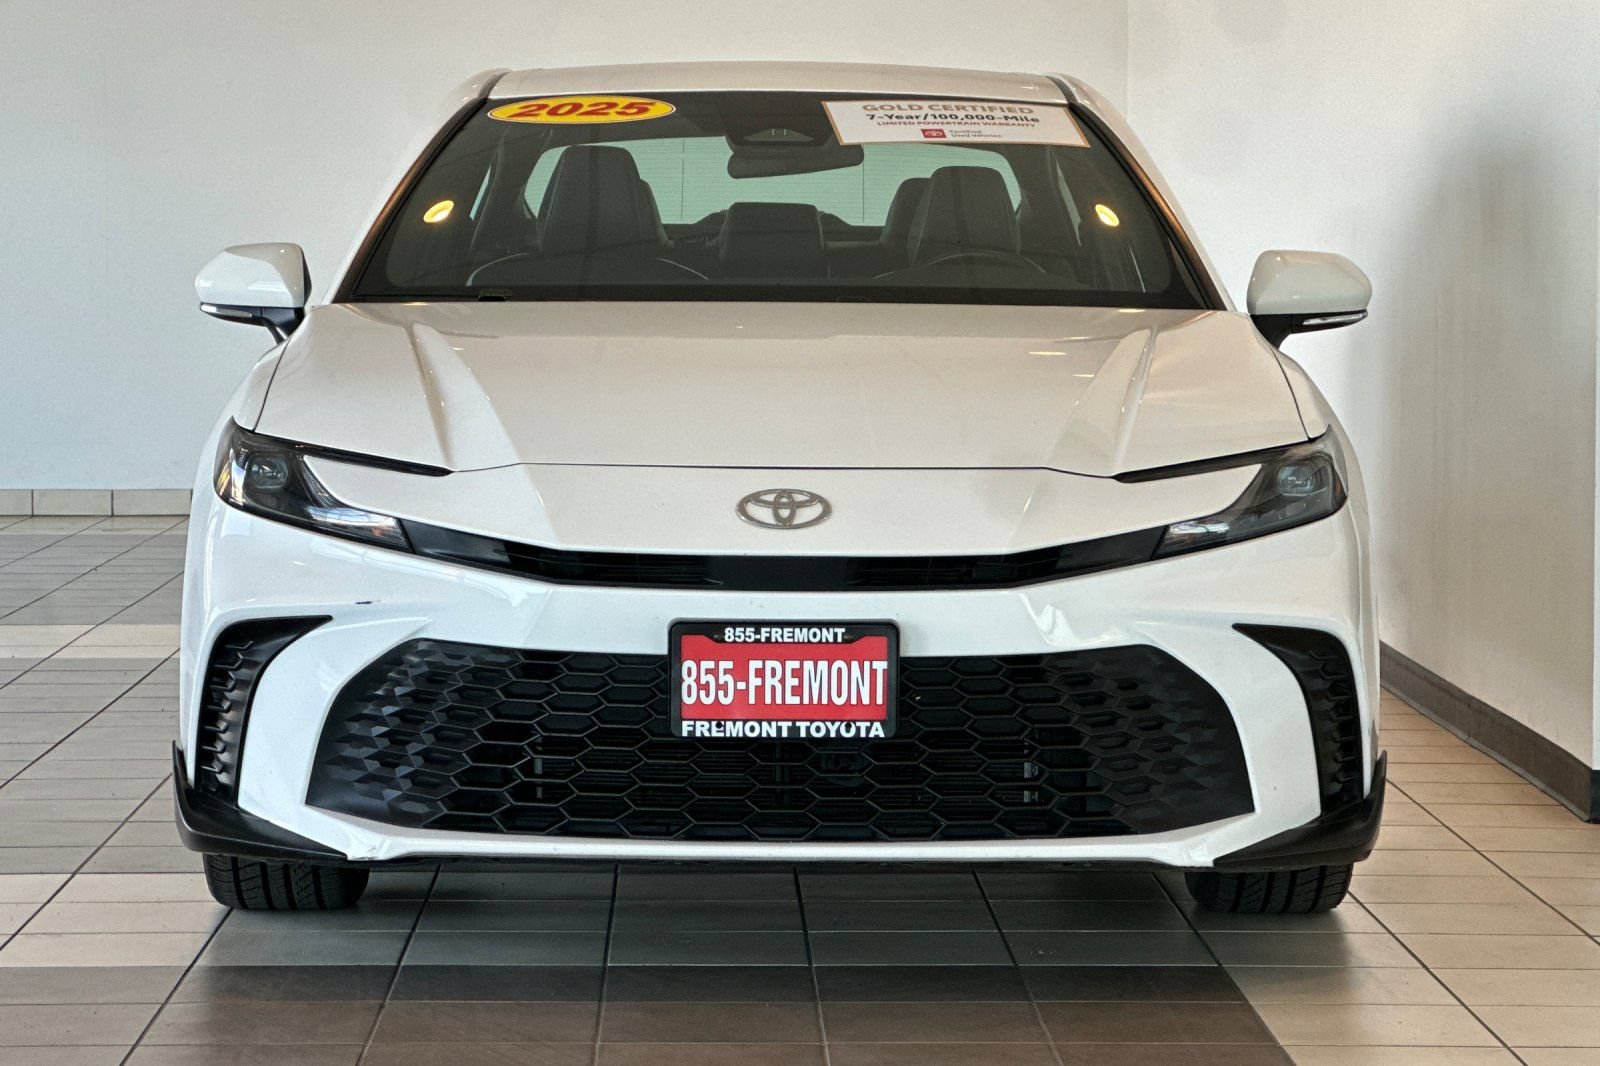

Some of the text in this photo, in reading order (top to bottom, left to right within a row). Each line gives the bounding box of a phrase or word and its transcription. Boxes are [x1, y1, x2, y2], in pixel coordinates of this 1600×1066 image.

[506, 101, 657, 118] 2025
[866, 112, 1040, 122] 7-Year/100,000-Mile
[927, 104, 1034, 114] CERTIFIED
[724, 627, 846, 643] 855-FREMONT
[681, 659, 888, 705] 855-FREMONT
[681, 720, 885, 738] FREMONT TOYOTA
